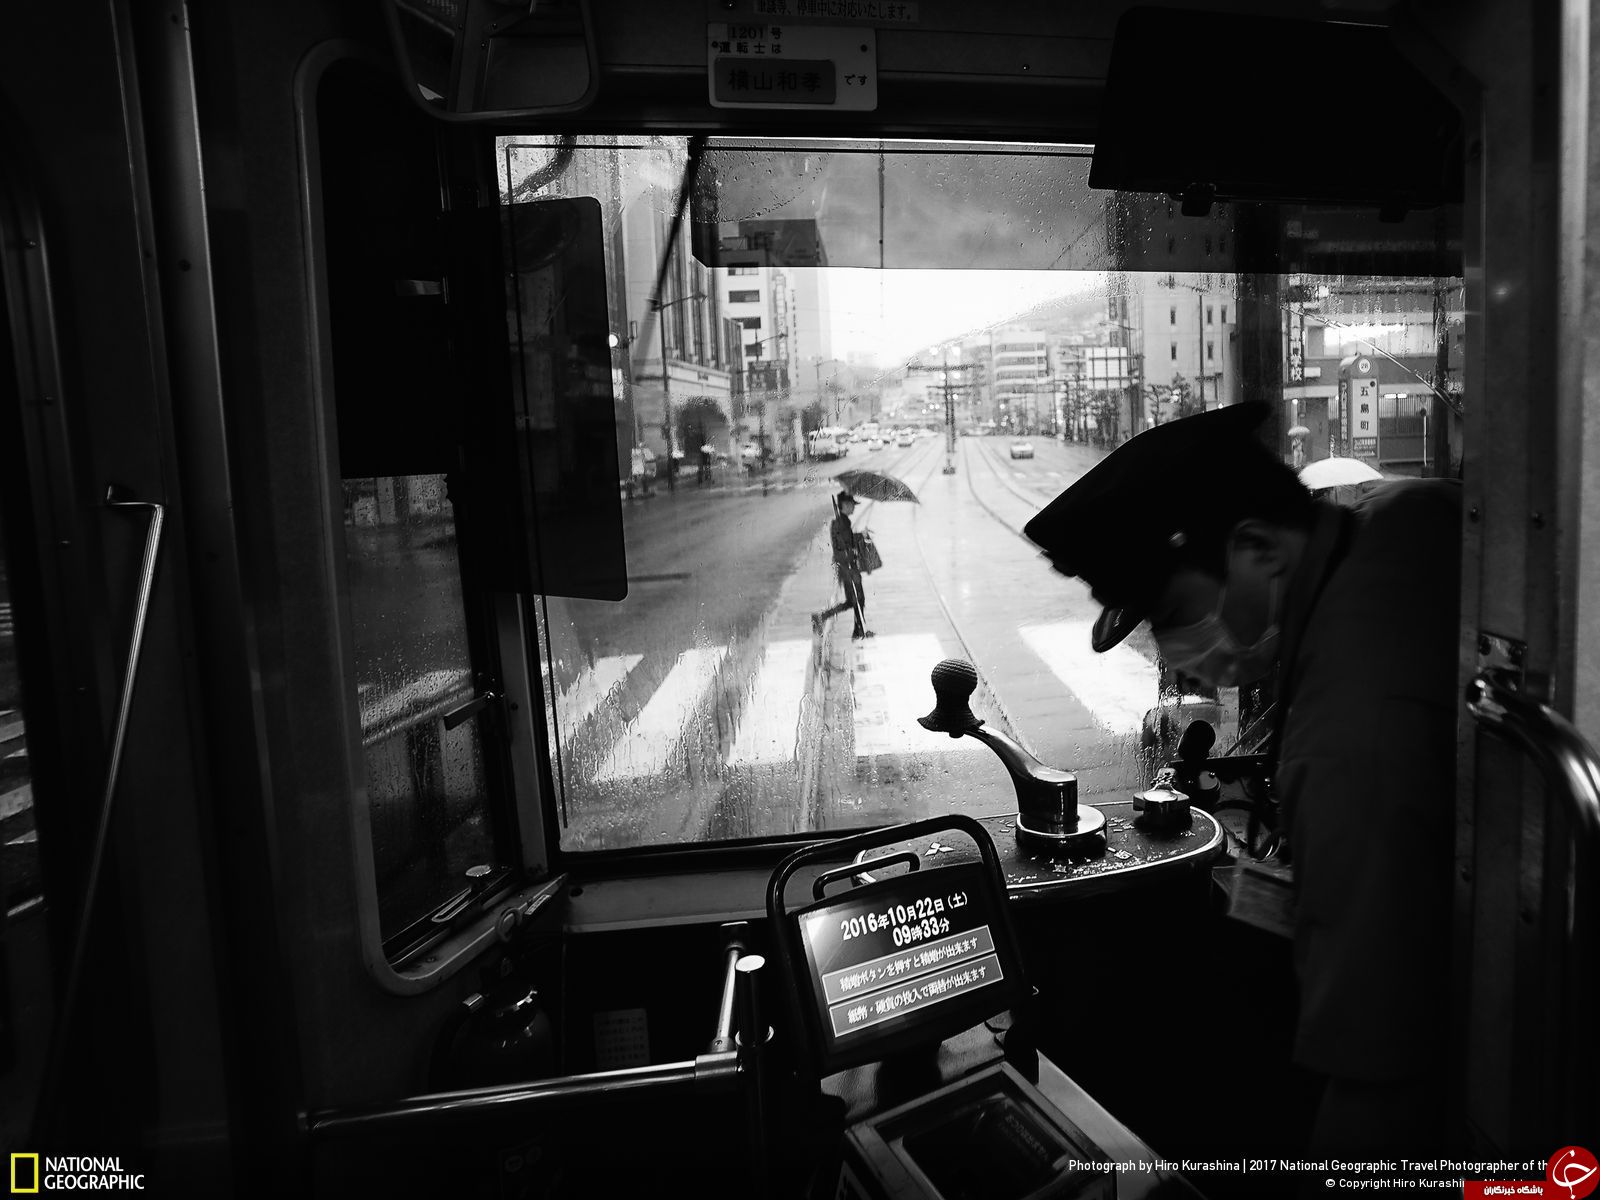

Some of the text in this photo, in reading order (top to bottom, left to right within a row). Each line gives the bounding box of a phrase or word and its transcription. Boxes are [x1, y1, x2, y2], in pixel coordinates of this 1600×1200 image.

[719, 41, 782, 54] 運転士は
[728, 68, 822, 93] 横山和孝
[844, 74, 868, 86] です
[892, 916, 950, 947] 09時33分
